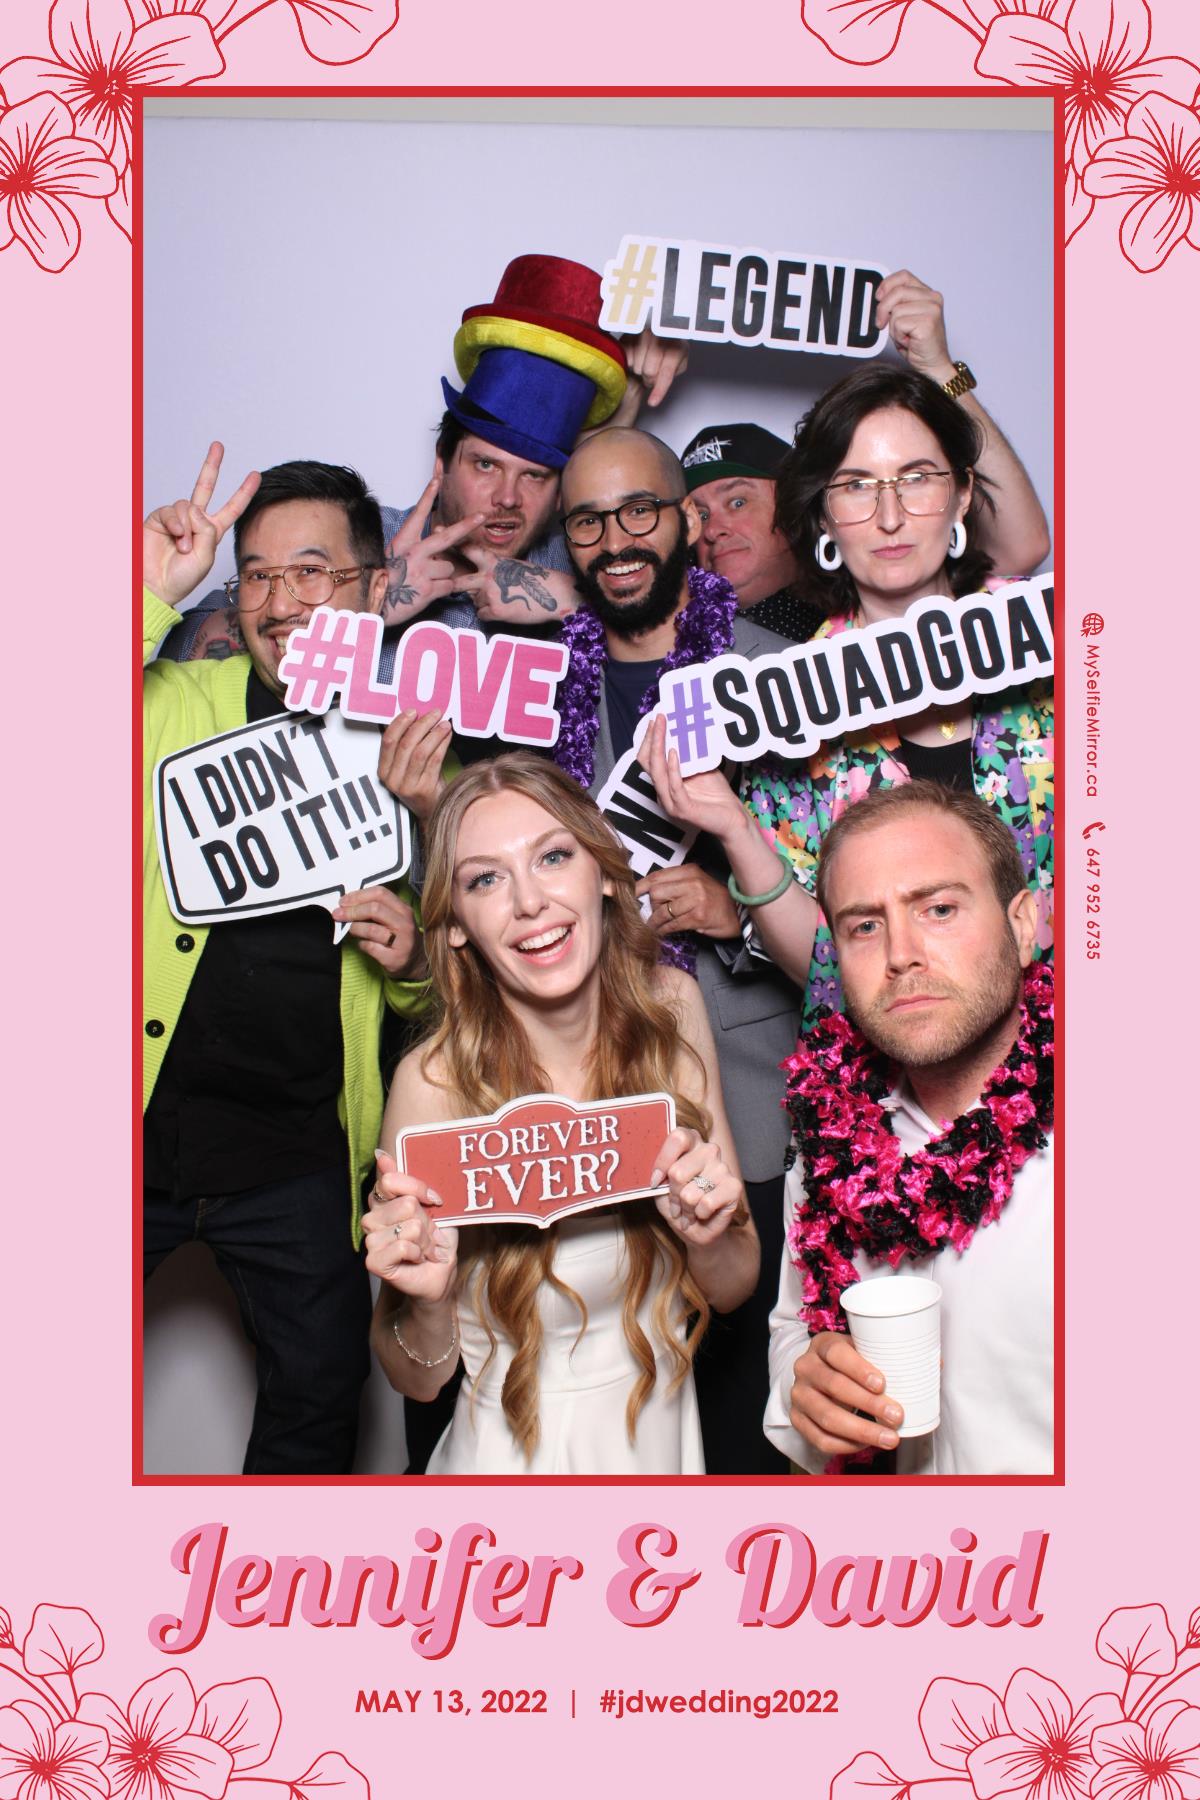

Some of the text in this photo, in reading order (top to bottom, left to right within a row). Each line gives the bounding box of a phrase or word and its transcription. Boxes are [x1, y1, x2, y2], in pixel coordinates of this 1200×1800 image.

[607, 243, 885, 349] #LEGEND
[283, 612, 565, 741] #LOVE
[666, 586, 1054, 764] #SQUADGOA
[168, 716, 339, 839] I DIDN'T
[200, 774, 394, 906] DO IT!!!
[458, 1114, 620, 1164] FOREVER
[462, 1149, 621, 1212] EVER?
